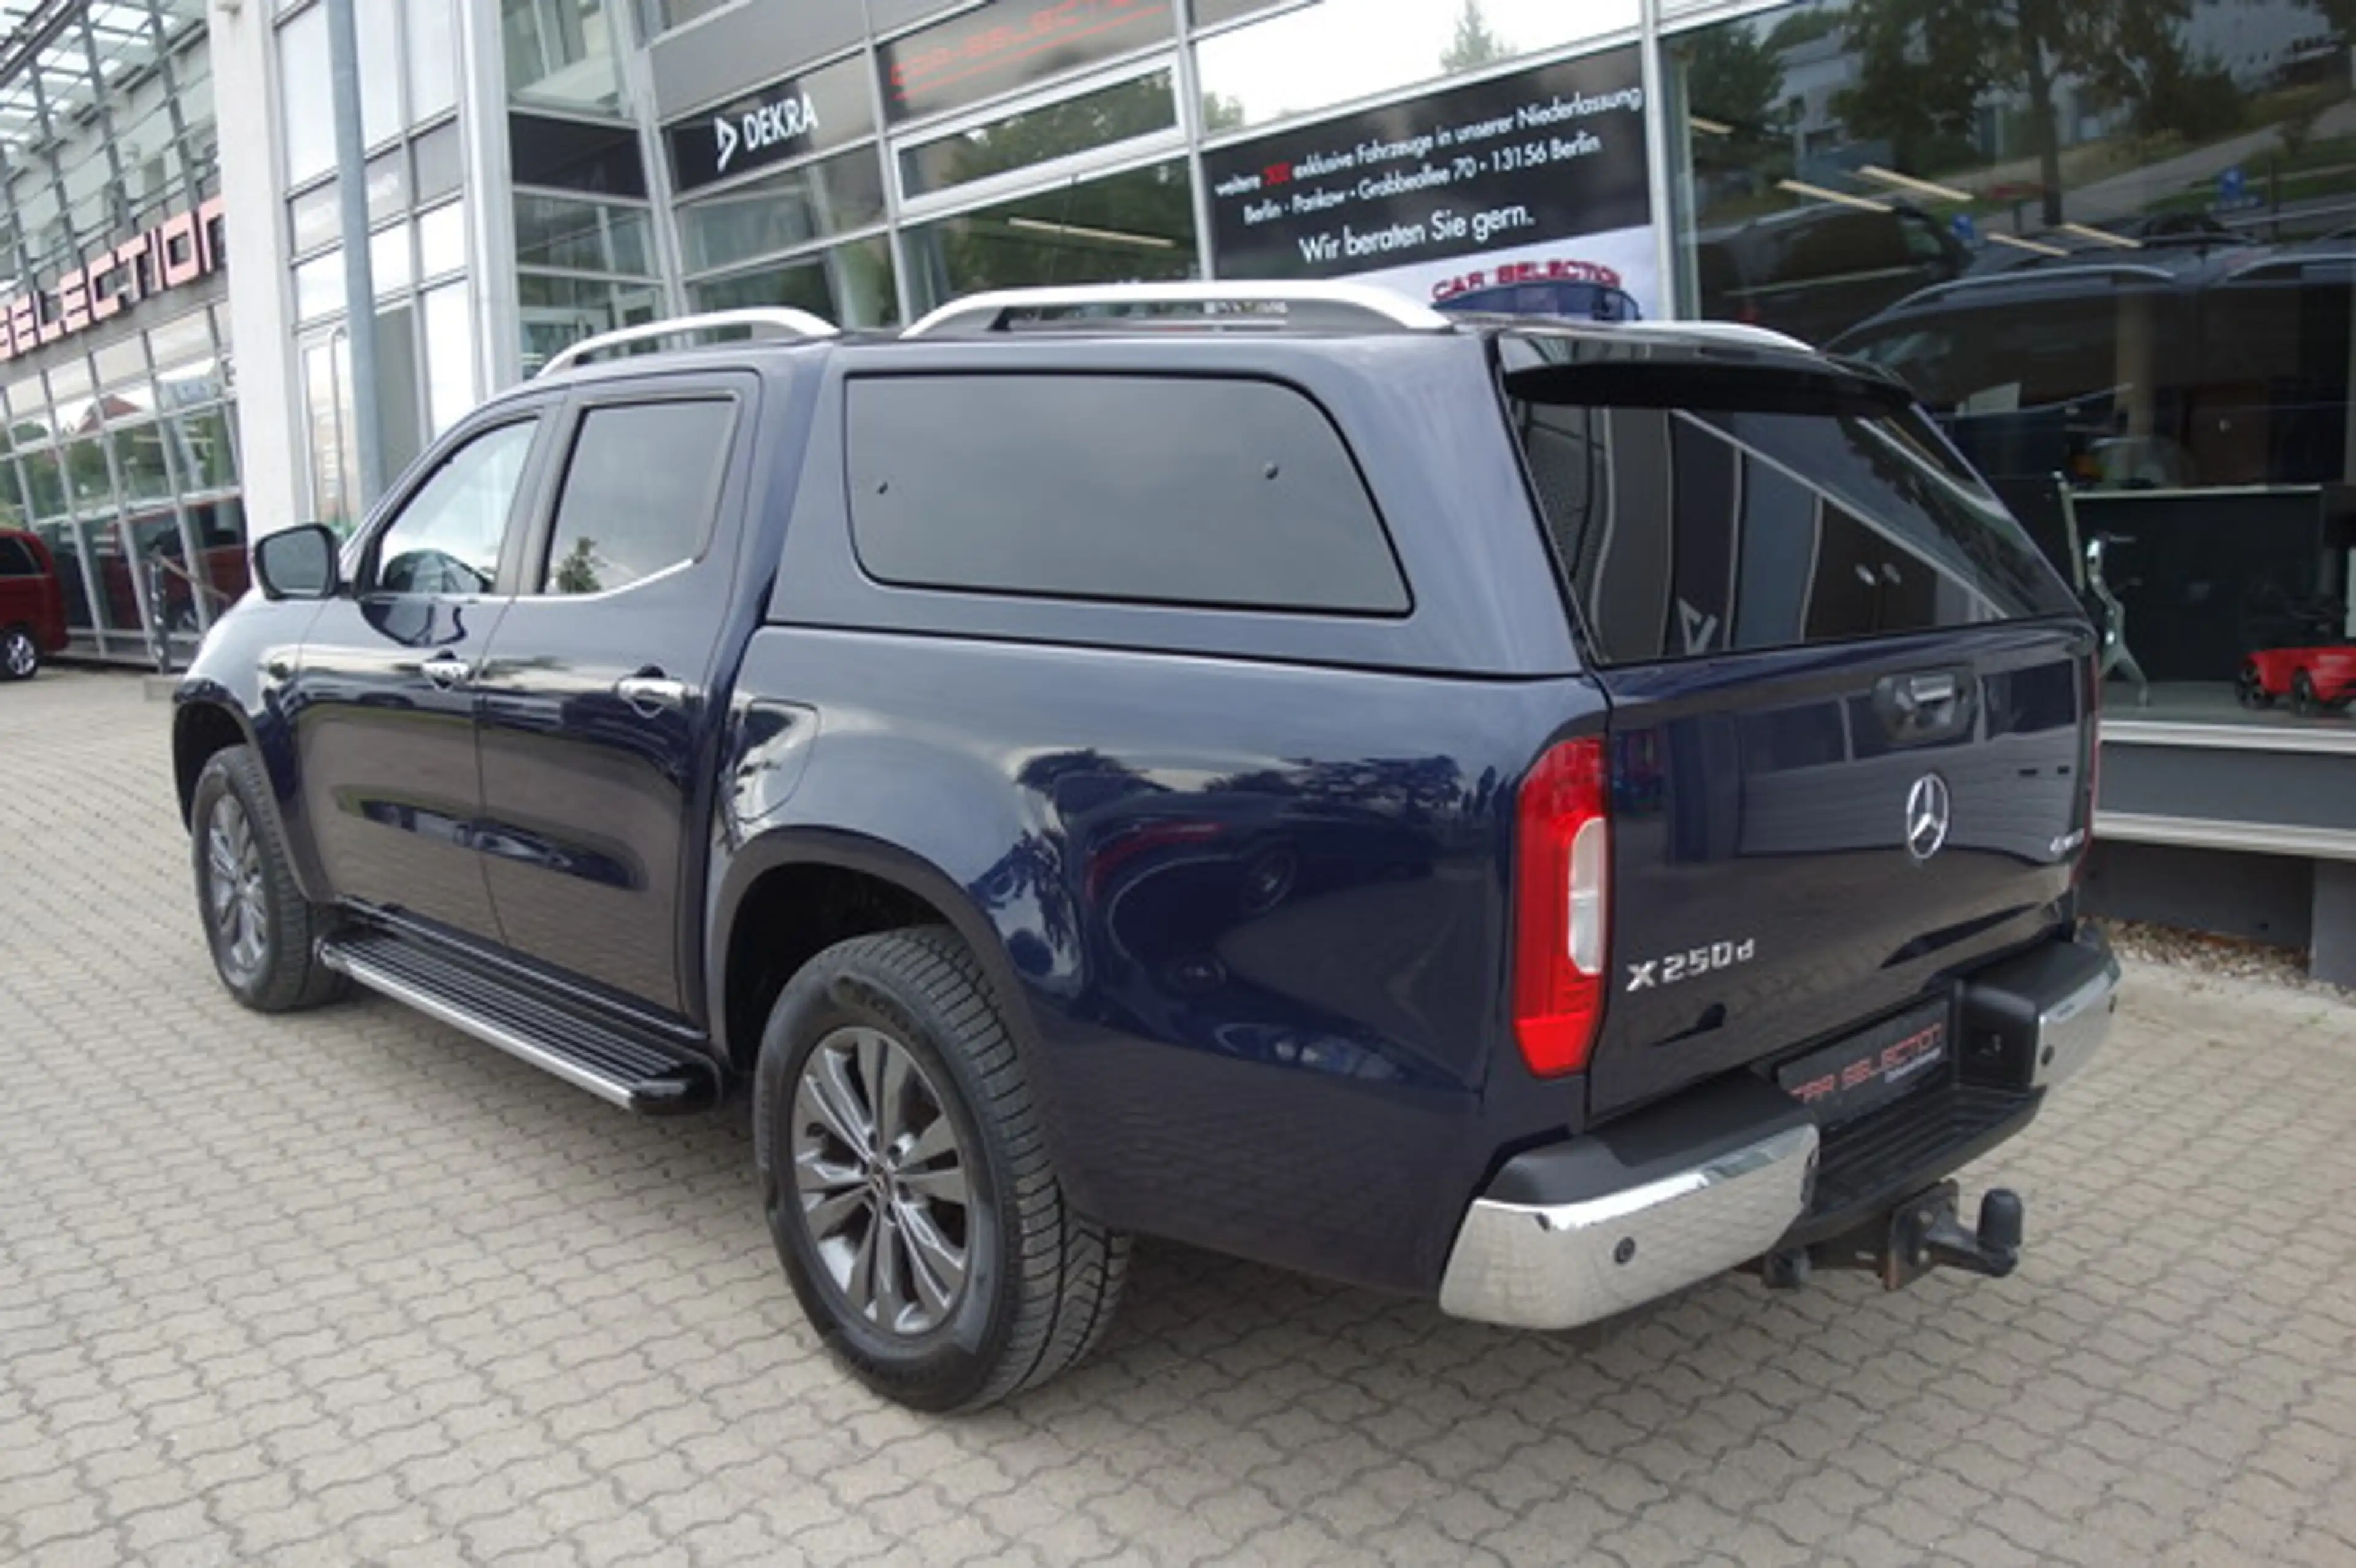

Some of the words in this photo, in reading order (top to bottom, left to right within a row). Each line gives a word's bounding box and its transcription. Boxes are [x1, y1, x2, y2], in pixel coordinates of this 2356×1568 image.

[742, 92, 818, 152] DEKRA
[1292, 151, 1353, 180] exklusive
[1355, 138, 1433, 164] Fahrzeuge
[1436, 125, 1452, 147] in
[1455, 117, 1514, 144] unserer
[1517, 88, 1642, 129] Niederlassung
[1244, 198, 1282, 225] Berlin
[1292, 187, 1346, 215] Pankow
[1453, 155, 1477, 182] 70
[1492, 139, 1547, 172] 13156
[1550, 130, 1603, 161] Berlin
[1298, 229, 1340, 263] Wir
[1343, 224, 1425, 256] beraten
[1431, 209, 1466, 241] Sie
[1472, 206, 1536, 243] gern.
[1432, 272, 1485, 302] CAR
